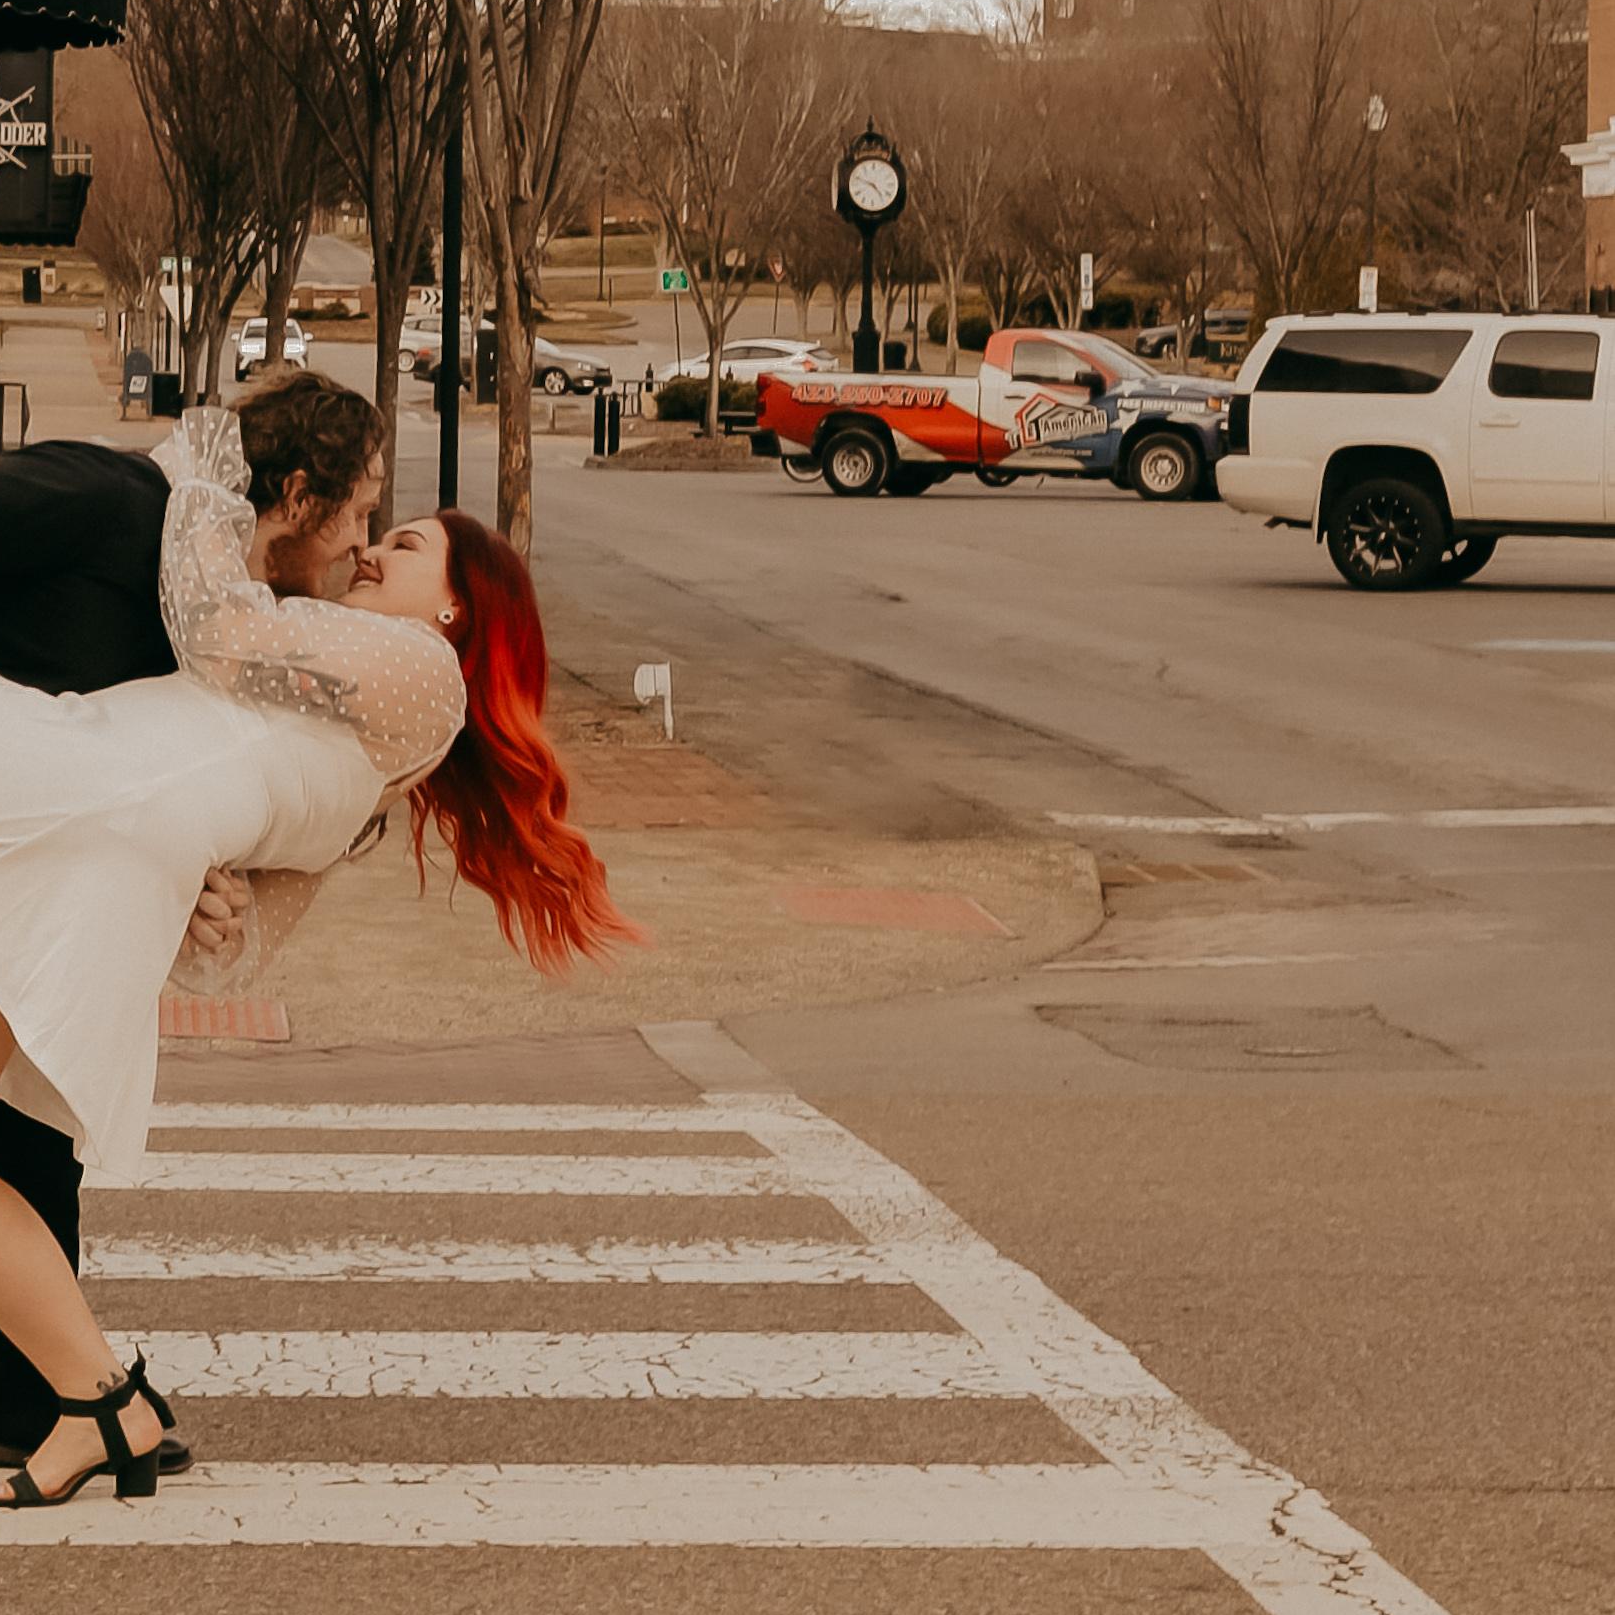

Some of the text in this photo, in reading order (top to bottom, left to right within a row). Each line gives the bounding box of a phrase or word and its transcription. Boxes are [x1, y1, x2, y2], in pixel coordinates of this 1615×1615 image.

[1117, 398, 1206, 413] FREE INSPECTIONS
[1042, 409, 1106, 434] American
